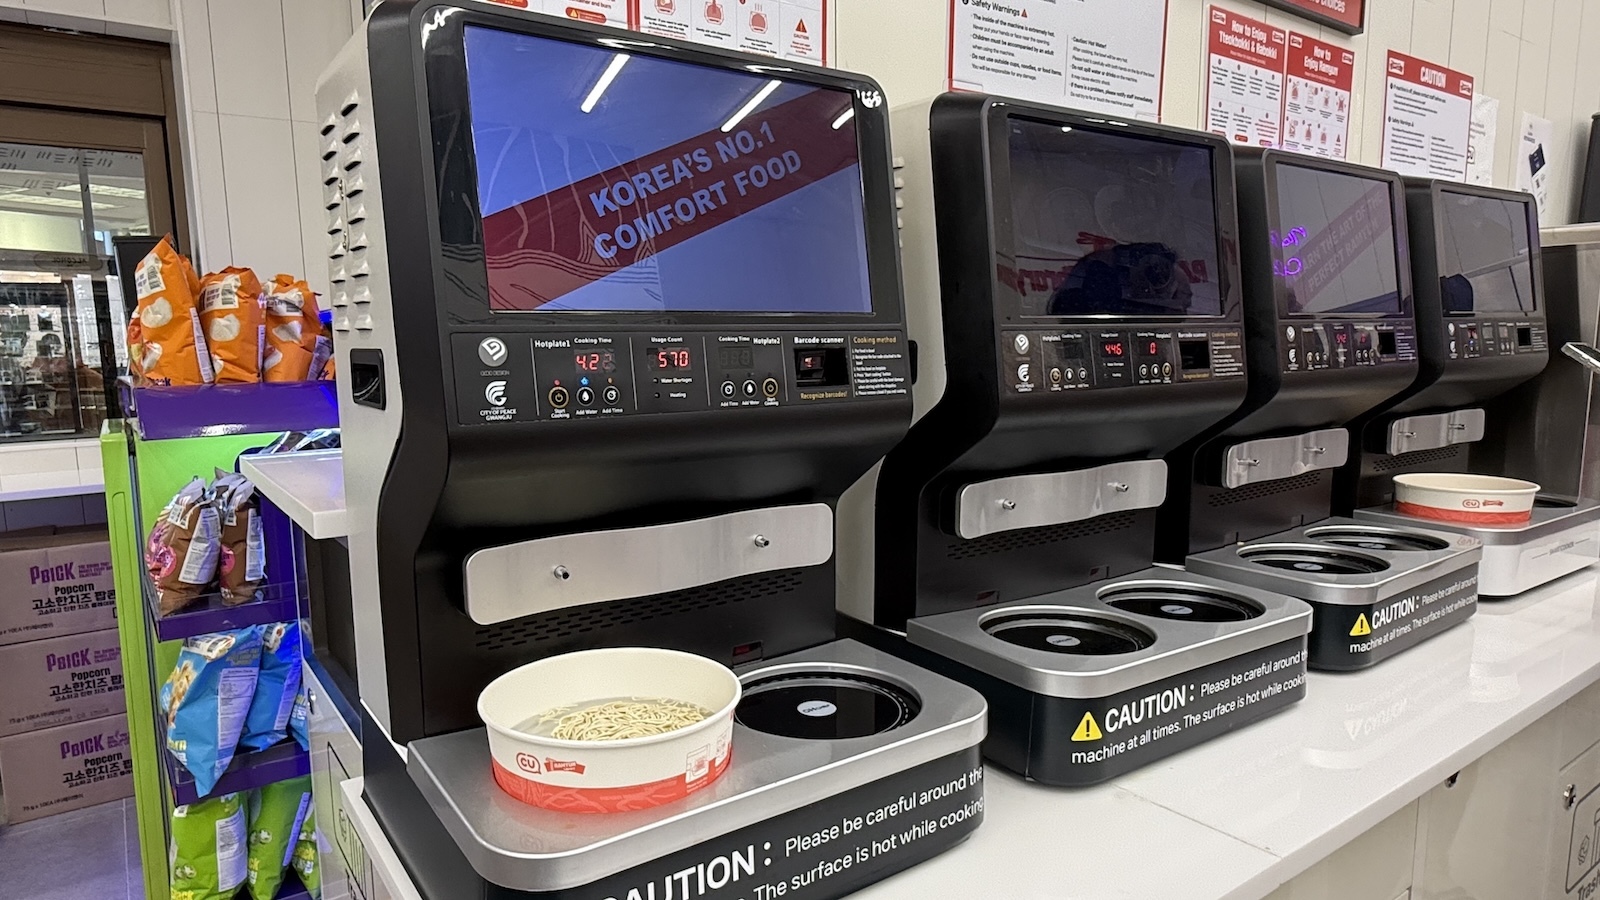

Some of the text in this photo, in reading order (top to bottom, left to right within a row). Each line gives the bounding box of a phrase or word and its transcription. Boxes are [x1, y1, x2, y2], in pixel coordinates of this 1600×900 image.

[971, 0, 1020, 17] Safety Warnings
[1231, 19, 1267, 44] How to Enjoy
[1420, 66, 1447, 89] CAUTION
[588, 121, 776, 218] KOREA'S NO.1
[593, 150, 802, 260] COMFORT FOOD
[1308, 248, 1345, 292] PERFECT
[535, 340, 571, 349] Hotplate1
[574, 337, 598, 345] Cooking
[753, 337, 781, 346] Hotplate2
[794, 336, 844, 345] Barcode scanner
[853, 336, 897, 346] Cooking method
[658, 351, 690, 368] 570
[801, 389, 848, 402] Recognize barcodes!
[30, 562, 76, 585] PBICK
[54, 583, 95, 597] Popcorn
[1422, 594, 1438, 606] Please
[1438, 590, 1445, 600] be
[1445, 581, 1461, 597] careful
[32, 593, 93, 611] 고소한치즈
[1349, 636, 1383, 654] machine
[1382, 635, 1389, 644] at
[1412, 617, 1422, 630] The
[1422, 610, 1441, 626] surface
[1440, 607, 1446, 617] is
[1446, 603, 1454, 614] hot
[1454, 597, 1466, 611] while
[46, 648, 92, 672] PBICK
[49, 674, 124, 698] 고소한치즈 팝
[71, 667, 111, 682] Popcorn
[1200, 677, 1230, 699] Please
[1231, 672, 1243, 686] be
[1243, 661, 1272, 683] careful
[1272, 651, 1301, 672] around
[1071, 741, 1125, 764] machine
[1127, 737, 1138, 752] at
[1139, 730, 1151, 747] all
[1152, 720, 1182, 742] times.
[1183, 714, 1202, 730] The
[1202, 700, 1236, 722] surface
[1236, 695, 1245, 709] is
[1245, 690, 1261, 706] hot
[1260, 681, 1282, 700] while
[60, 733, 106, 759] PBICK
[84, 752, 123, 768] Popcorn
[520, 756, 535, 770] CU
[62, 762, 121, 784] 고소한치즈
[603, 765, 984, 900] UTION: Please be careful around the
[753, 881, 788, 900] The
[790, 855, 854, 892] surface
[855, 844, 869, 865] is
[870, 834, 897, 860] hot
[898, 821, 938, 847] while
